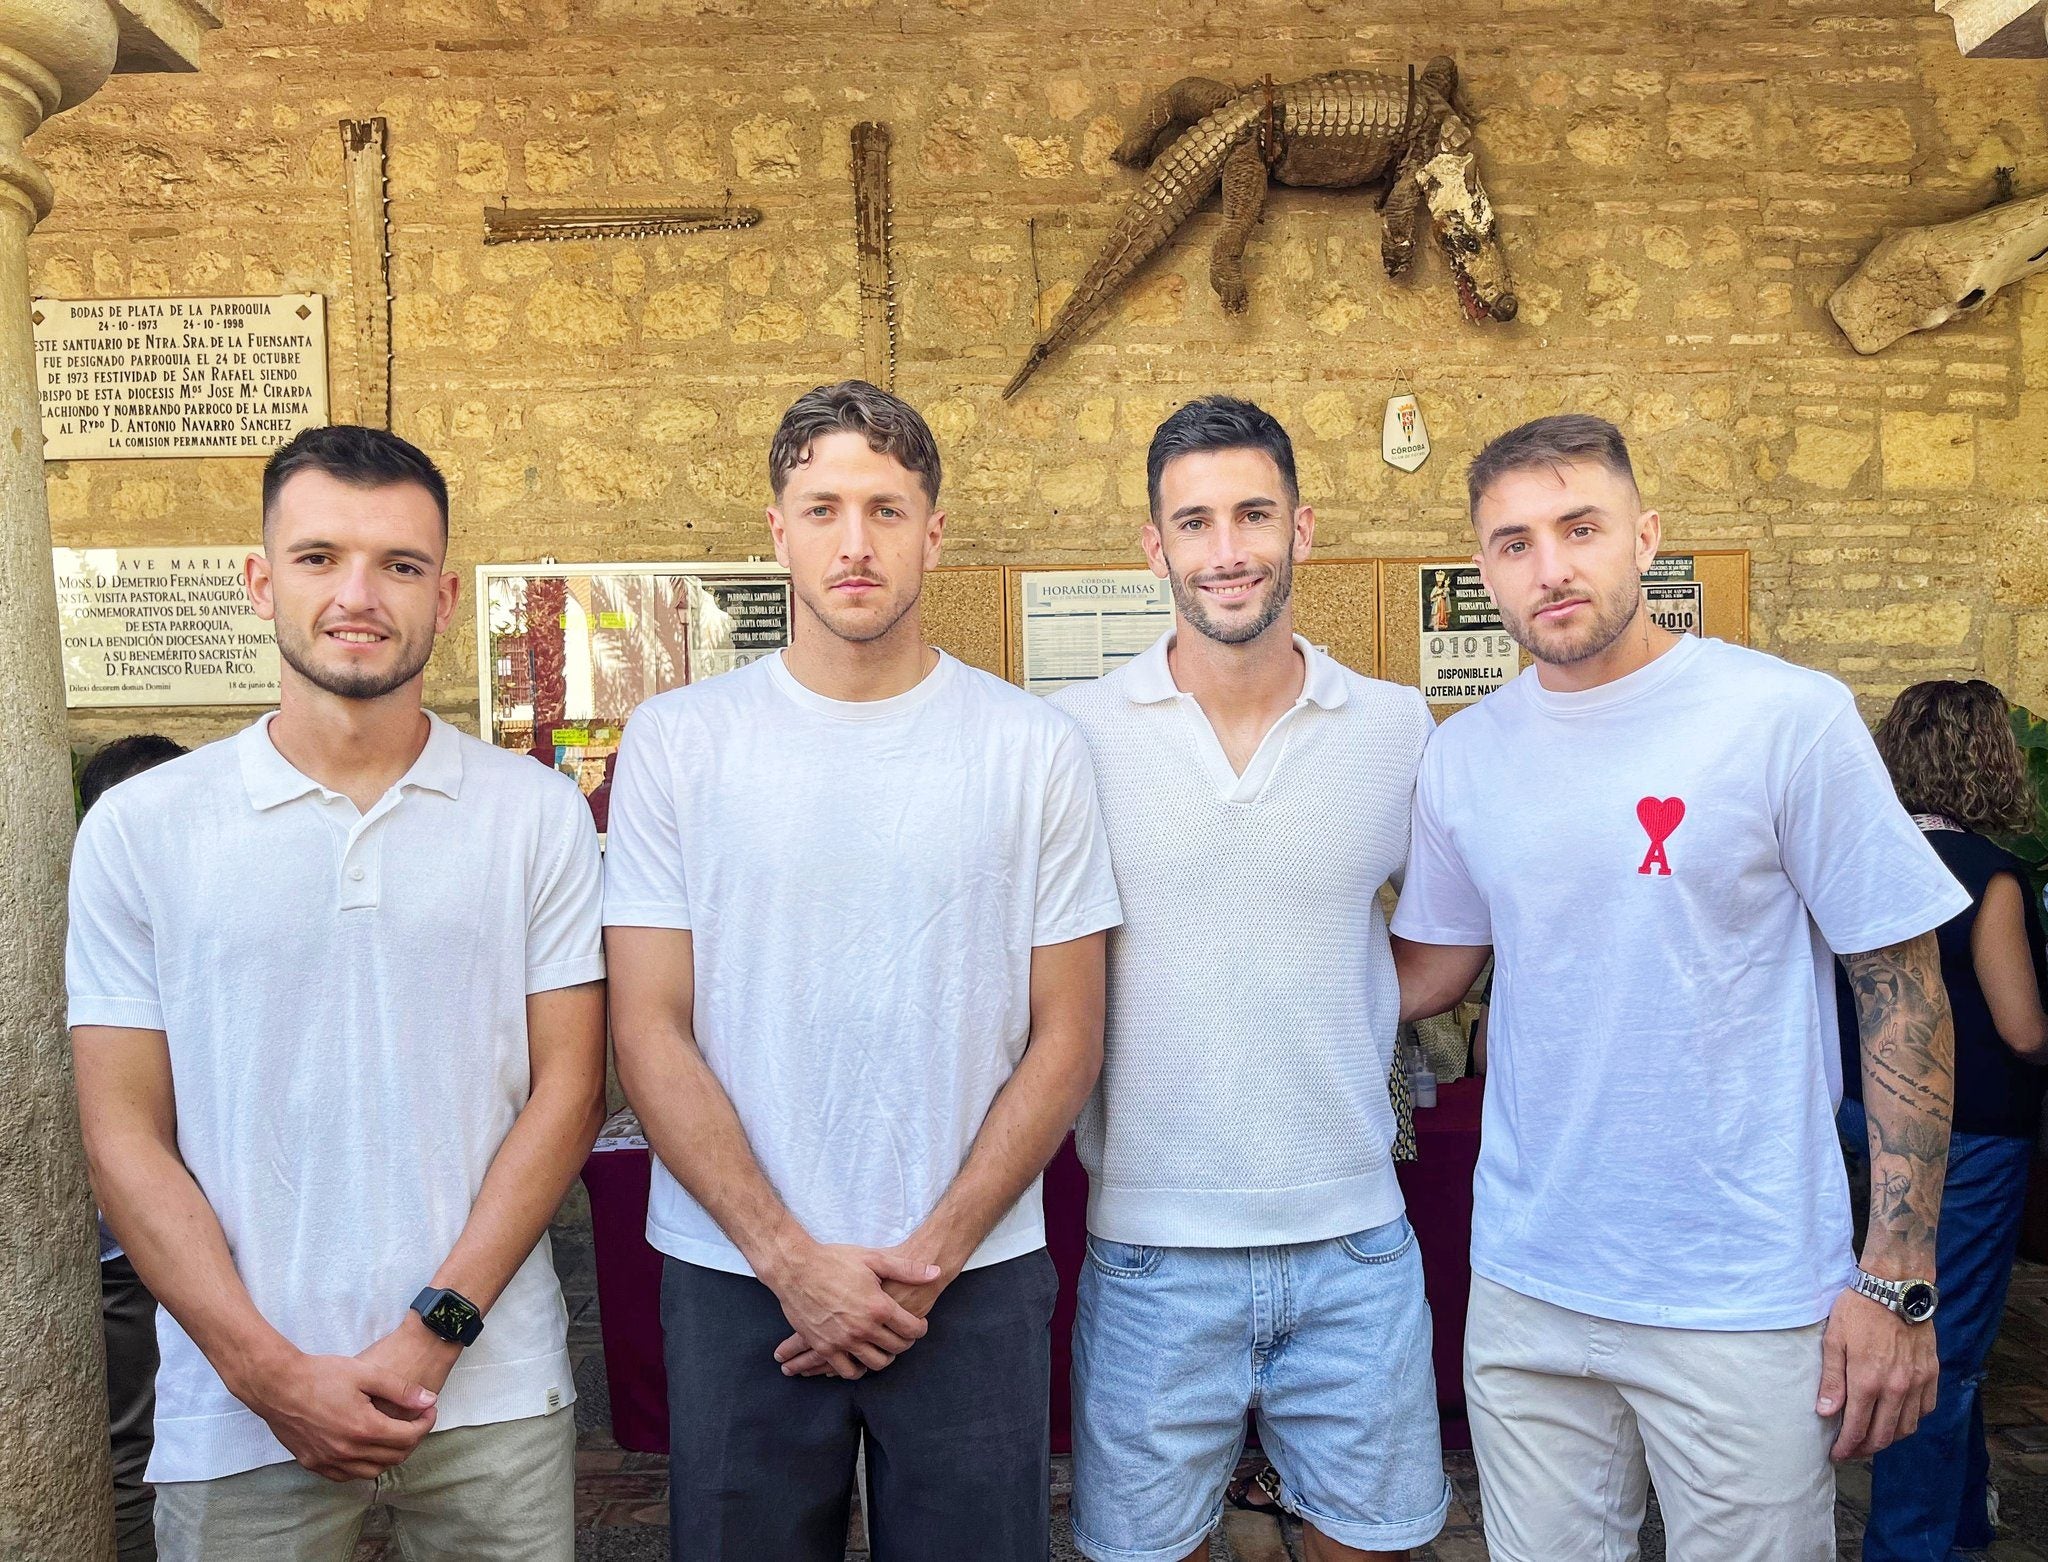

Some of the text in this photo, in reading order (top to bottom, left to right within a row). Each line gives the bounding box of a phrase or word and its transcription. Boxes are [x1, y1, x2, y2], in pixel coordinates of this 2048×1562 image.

[71, 304, 271, 318] BODAS DE PLATA DE LA PARROQUIA
[62, 338, 122, 351] SANTUARIO
[127, 338, 140, 349] DE
[211, 337, 224, 348] DE
[228, 336, 242, 348] LA
[248, 333, 312, 347] FUENSANTA
[44, 353, 301, 368] FUE DESIGNADO PARROQUIA EL 24 DE OCTUBRE
[48, 367, 297, 384] DE 1973 FESTIVIDAD DE SAN RAFAEL SIENDO
[76, 389, 89, 401] DE
[95, 389, 122, 400] ESTA
[128, 388, 174, 400] DIOCESIS
[207, 384, 234, 398] JOSE
[264, 383, 312, 398] CIRARDA
[103, 405, 110, 416] Y
[114, 404, 180, 416] NOMBRANDO
[184, 403, 232, 414] PARROCO
[236, 403, 249, 414] DE
[253, 403, 267, 414] LA
[272, 402, 308, 414] MISMA
[60, 423, 73, 434] AL
[111, 419, 123, 433] D.
[127, 419, 176, 433] ANTONIO
[182, 418, 234, 432] NAVARRO
[241, 417, 291, 431] SANCHEZ
[109, 438, 121, 447] LA
[125, 437, 170, 447] COMISION
[174, 436, 237, 446] PERMANANTE
[241, 436, 258, 446] DEL
[120, 559, 235, 570] AVE MARIA
[112, 575, 167, 588] DEMETRIO
[171, 574, 234, 586] FERNÁNDEZ
[1457, 576, 1481, 585] PARROQUI
[95, 593, 127, 602] VISITA
[130, 592, 186, 602] PASTORAL,
[188, 588, 244, 601] INAUGURÓ
[1043, 584, 1155, 595] HORARIO DE MISAS
[75, 607, 173, 618] CONMEMORATIVOS
[176, 606, 196, 616] DEL
[200, 606, 209, 616] 50
[769, 606, 775, 614] DE
[776, 606, 782, 614] LA
[1481, 615, 1487, 623] DE
[126, 620, 233, 632] DE ESTA PARROQUIA,
[65, 634, 277, 647] CON LA BENDICIÓN DIOCESANA Y HOMEN
[1430, 636, 1511, 654] 01015
[104, 647, 257, 661] A SU BENEMÉRITO SACRISTÁN
[106, 661, 255, 676] D. FRANCISCO RUEDA RICO.
[1438, 668, 1503, 679] DISPONIBLE LA
[248, 681, 265, 690] junio
[1425, 686, 1462, 696] LOTERIA
[1464, 685, 1476, 696] DE
